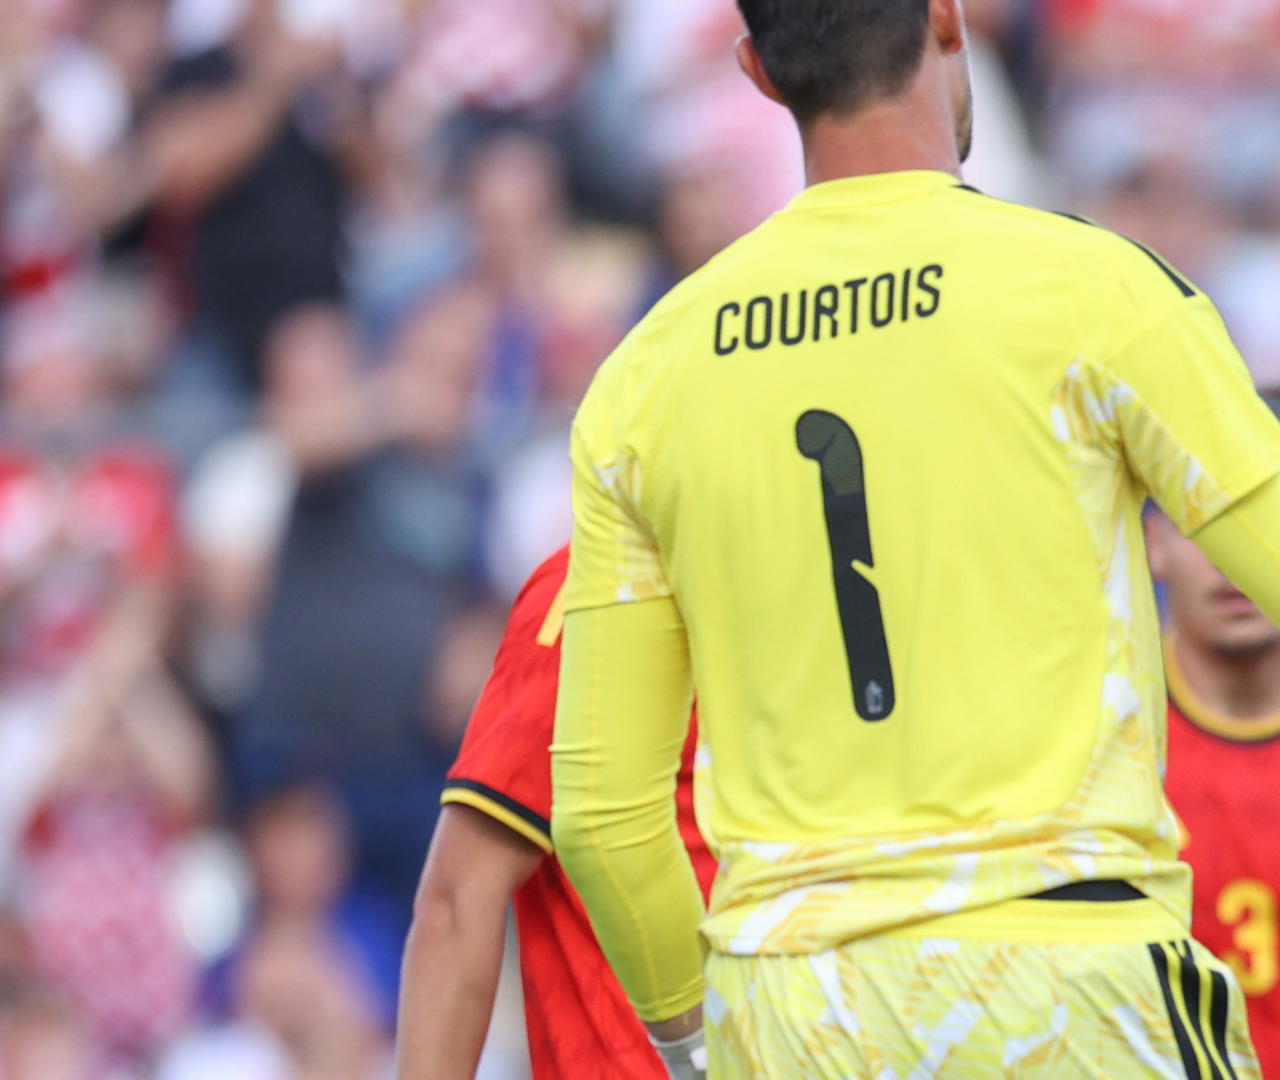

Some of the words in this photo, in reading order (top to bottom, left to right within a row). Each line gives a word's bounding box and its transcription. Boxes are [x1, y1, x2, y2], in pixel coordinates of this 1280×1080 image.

[714, 264, 943, 356] COURTOIS
[796, 409, 896, 722] 1
[1216, 879, 1279, 997] 3
